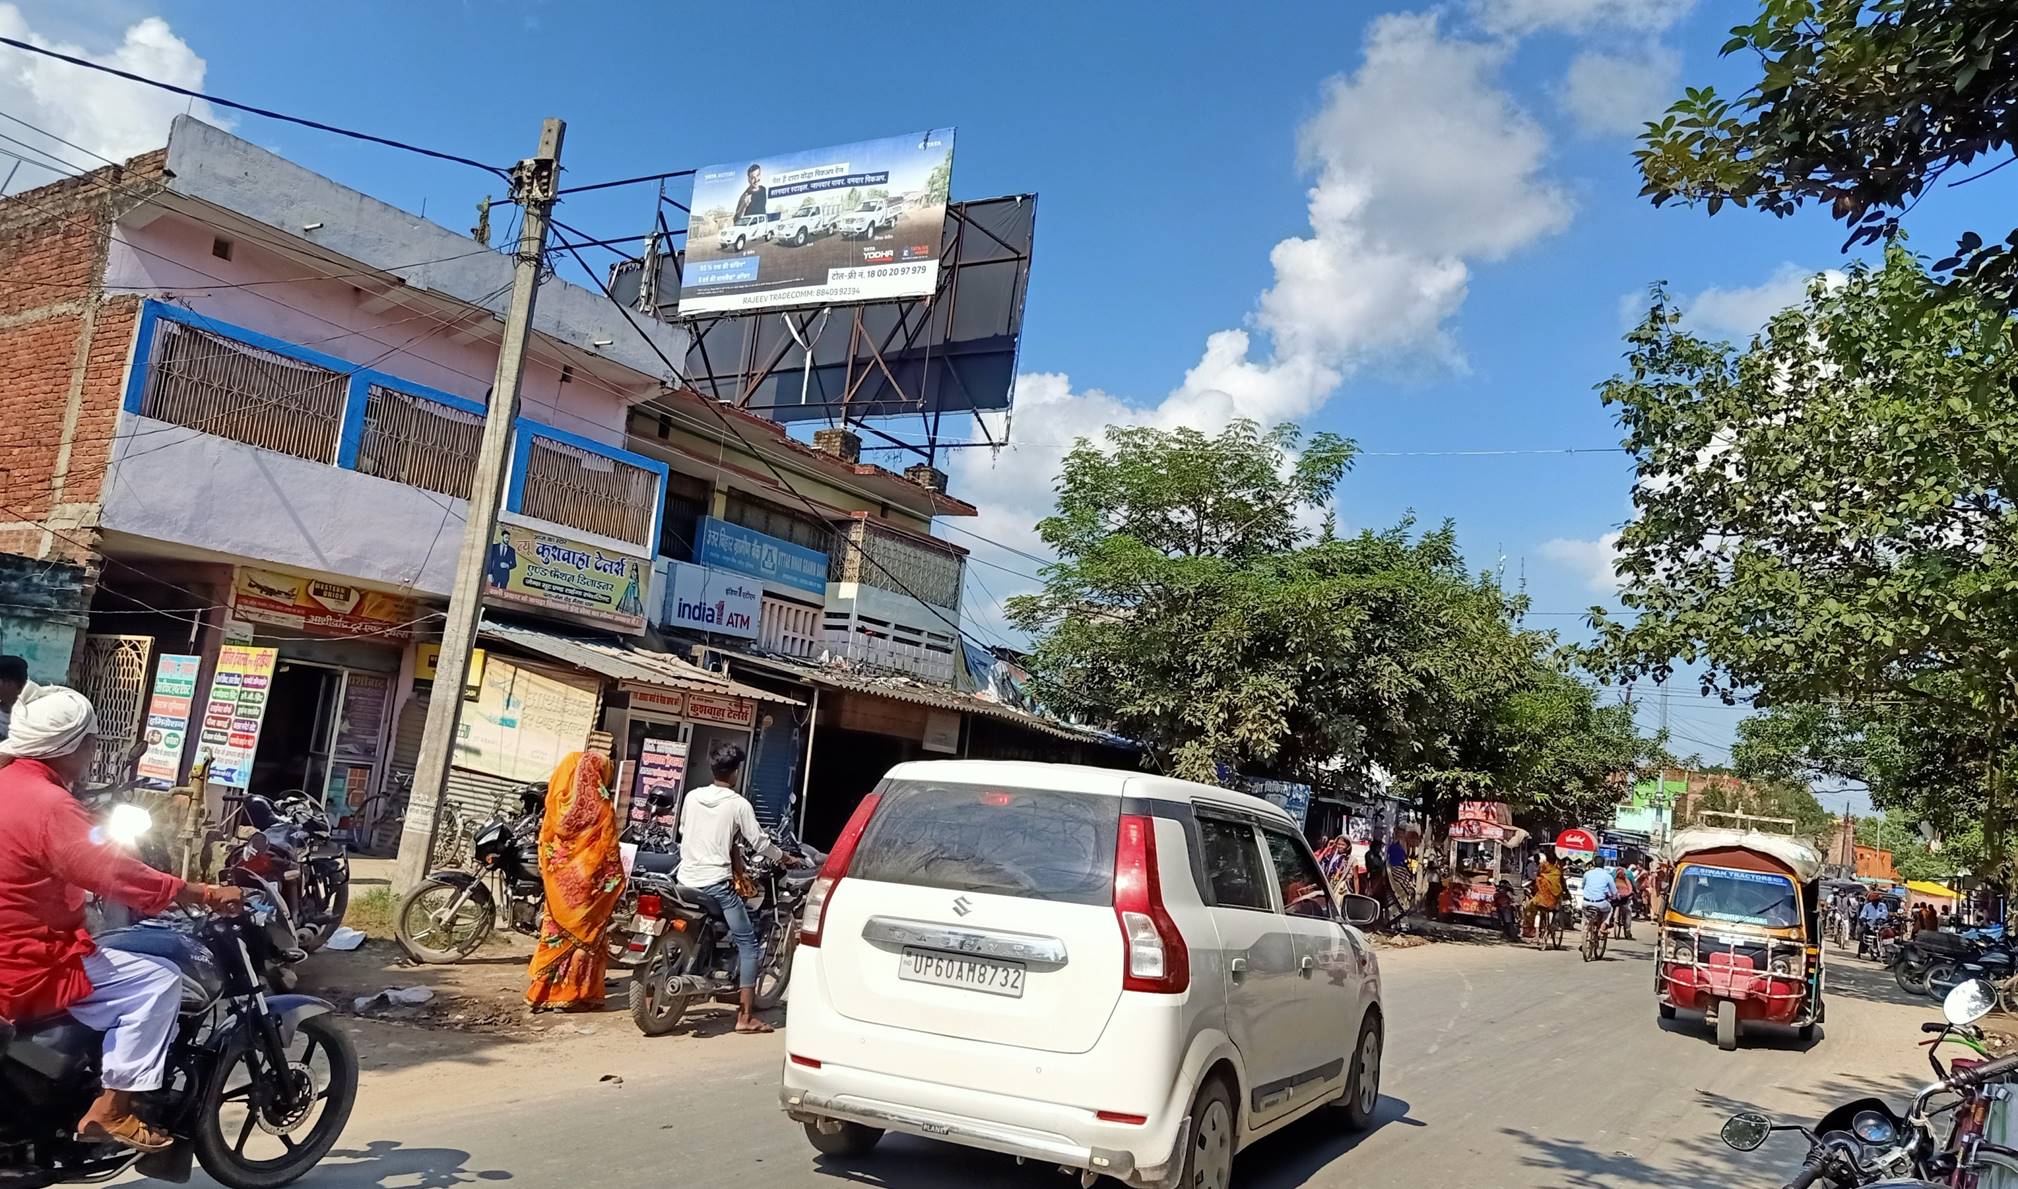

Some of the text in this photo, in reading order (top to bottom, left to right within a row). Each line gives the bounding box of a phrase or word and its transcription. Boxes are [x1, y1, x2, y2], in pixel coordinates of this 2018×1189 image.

[867, 270, 875, 278] 18
[877, 269, 888, 277] 00
[889, 268, 899, 276] 20
[901, 267, 910, 275] 97
[912, 265, 927, 275] 979
[743, 296, 768, 304] RAJEEV
[536, 542, 591, 570] कुशवाहा
[594, 551, 626, 578] टेलर्स
[315, 581, 346, 594] WESTERN
[322, 590, 345, 601] UNION
[725, 611, 750, 630] ATM
[690, 702, 726, 718] कुशवाहा
[1700, 868, 1772, 881] SIWAN TRACTORS
